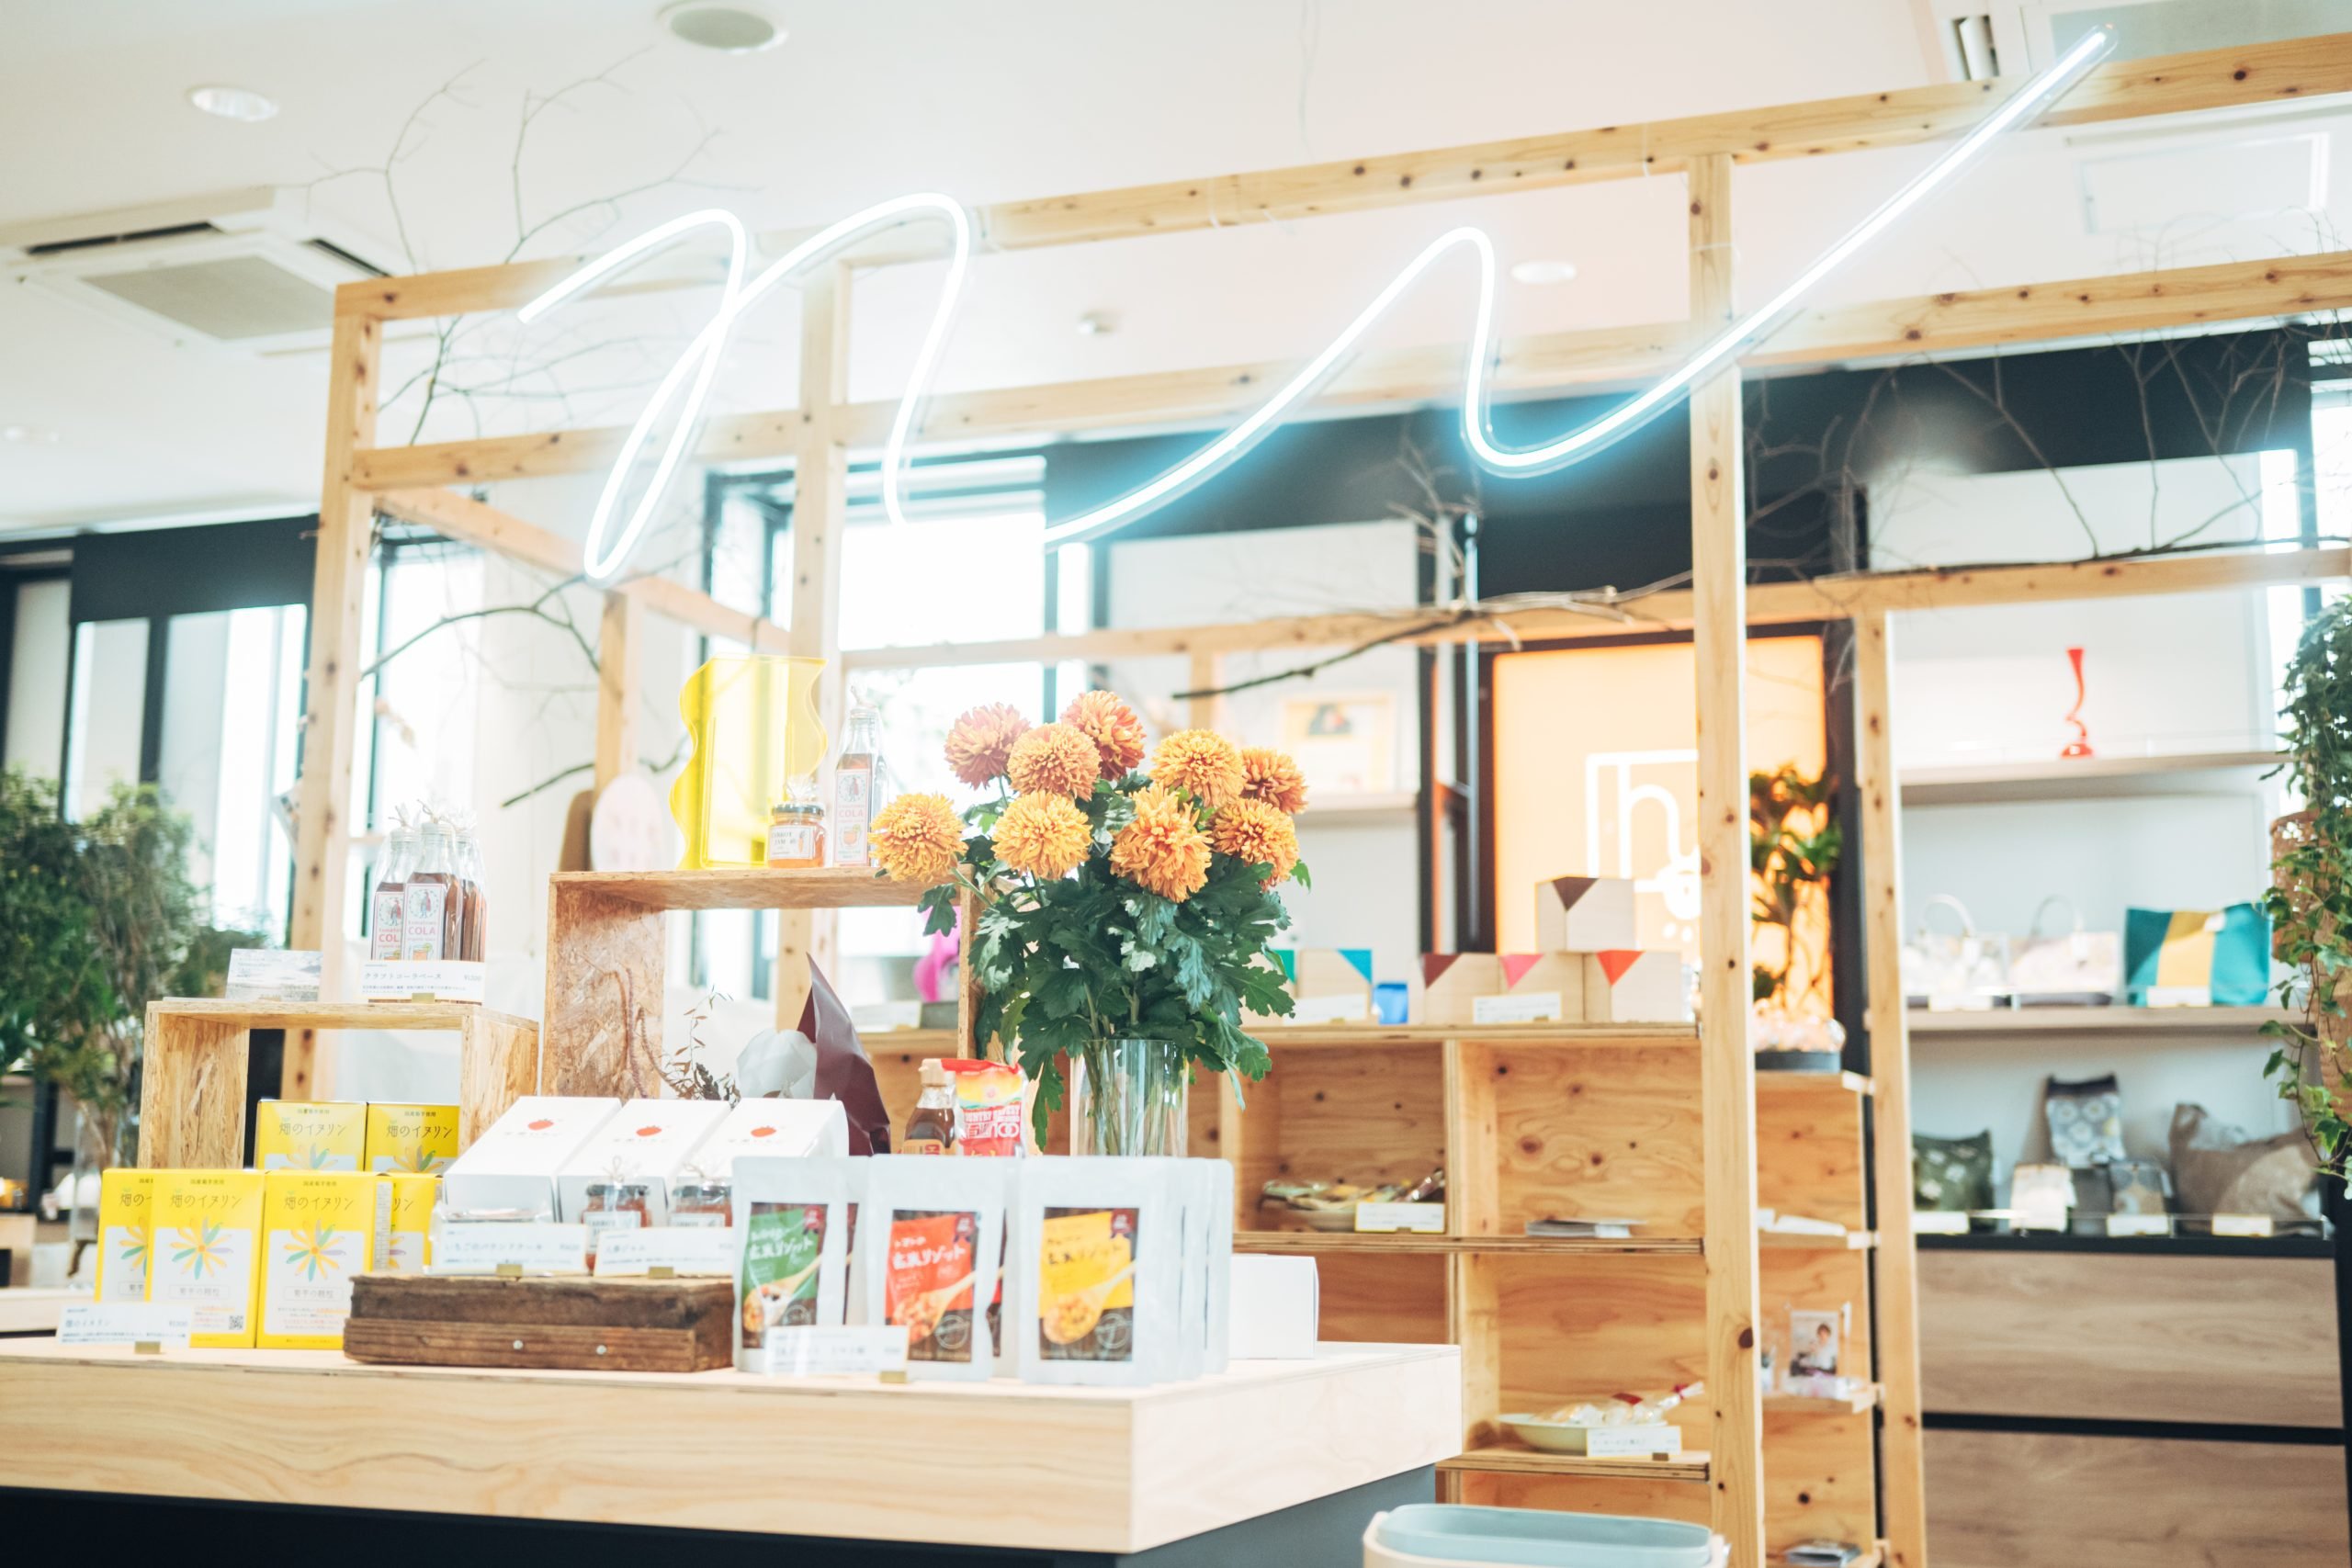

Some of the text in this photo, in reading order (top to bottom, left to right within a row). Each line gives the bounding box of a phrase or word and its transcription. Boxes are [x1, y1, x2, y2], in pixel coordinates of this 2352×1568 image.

[379, 933, 400, 942] COL
[408, 926, 435, 935] COLA
[278, 1122, 346, 1136] 畑のイヌリン
[386, 1123, 453, 1139] 畑のイヌリン
[170, 1194, 243, 1209] 畑のイヌリン
[283, 1196, 354, 1211] 畑のイヌリン
